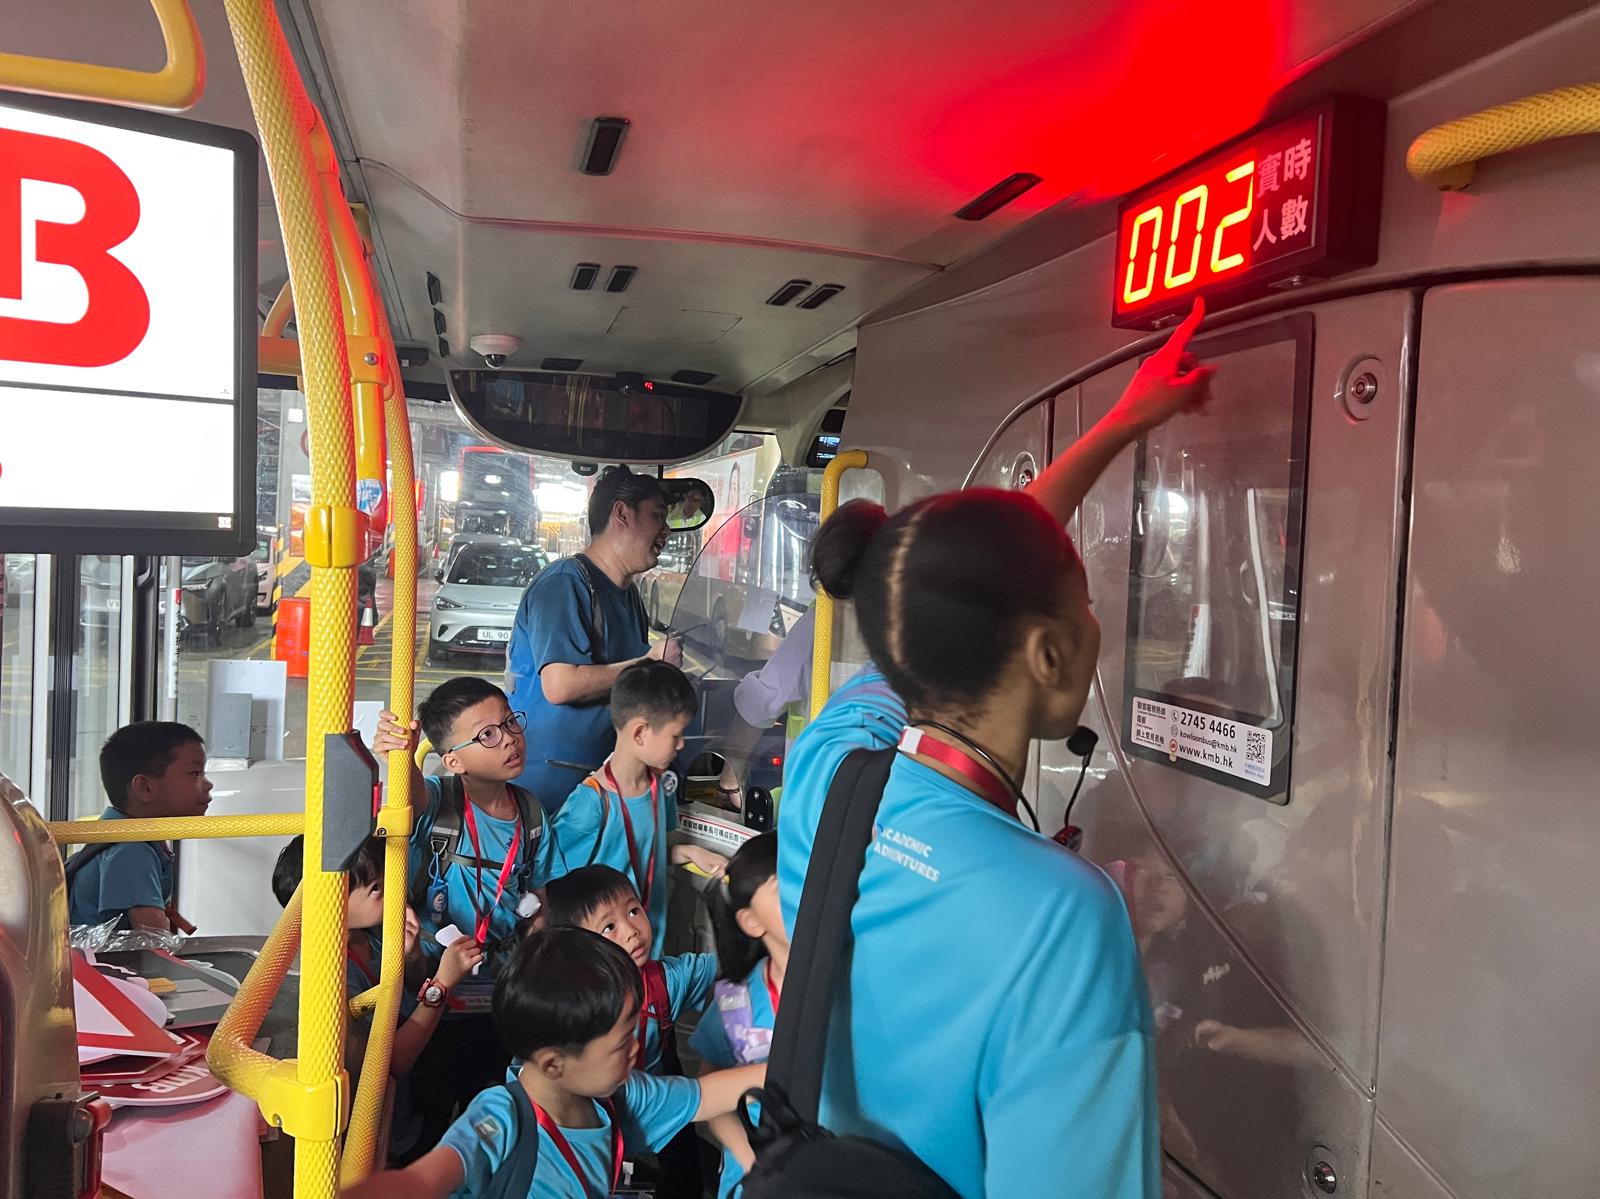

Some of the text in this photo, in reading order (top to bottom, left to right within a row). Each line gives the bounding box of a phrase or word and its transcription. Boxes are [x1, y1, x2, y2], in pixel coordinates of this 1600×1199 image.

[1257, 138, 1312, 199] 實時
[1124, 160, 1255, 304] 002
[1253, 195, 1308, 252] 人數
[1180, 730, 1237, 753] kowloonbus@kmb.hk
[1181, 712, 1206, 730] 2745
[1210, 720, 1236, 738] 4466
[1179, 745, 1233, 768] www.kmb.hk
